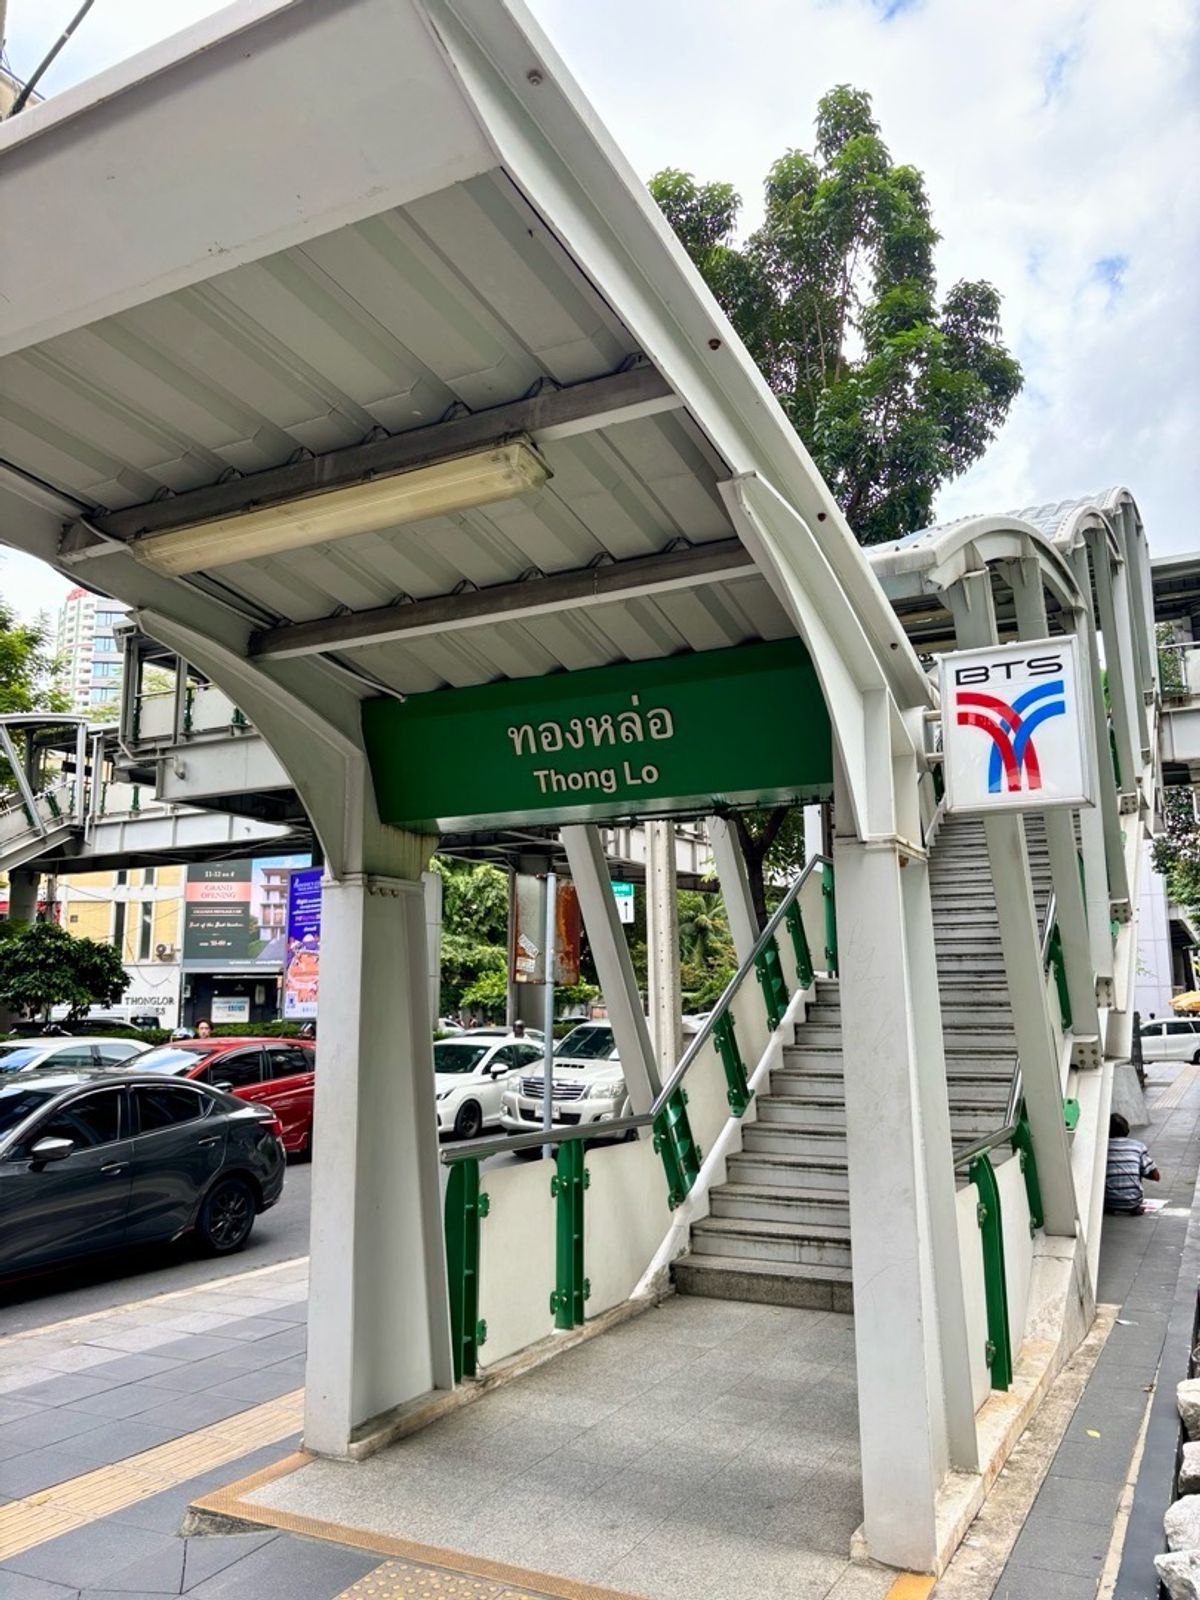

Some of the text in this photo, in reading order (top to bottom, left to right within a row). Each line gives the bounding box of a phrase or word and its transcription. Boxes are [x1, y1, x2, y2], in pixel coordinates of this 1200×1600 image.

[955, 654, 1063, 686] BTS
[508, 694, 674, 756] ทองหล่อ
[533, 761, 659, 794] Thong Lo
[125, 996, 175, 1006] THONGLOR
